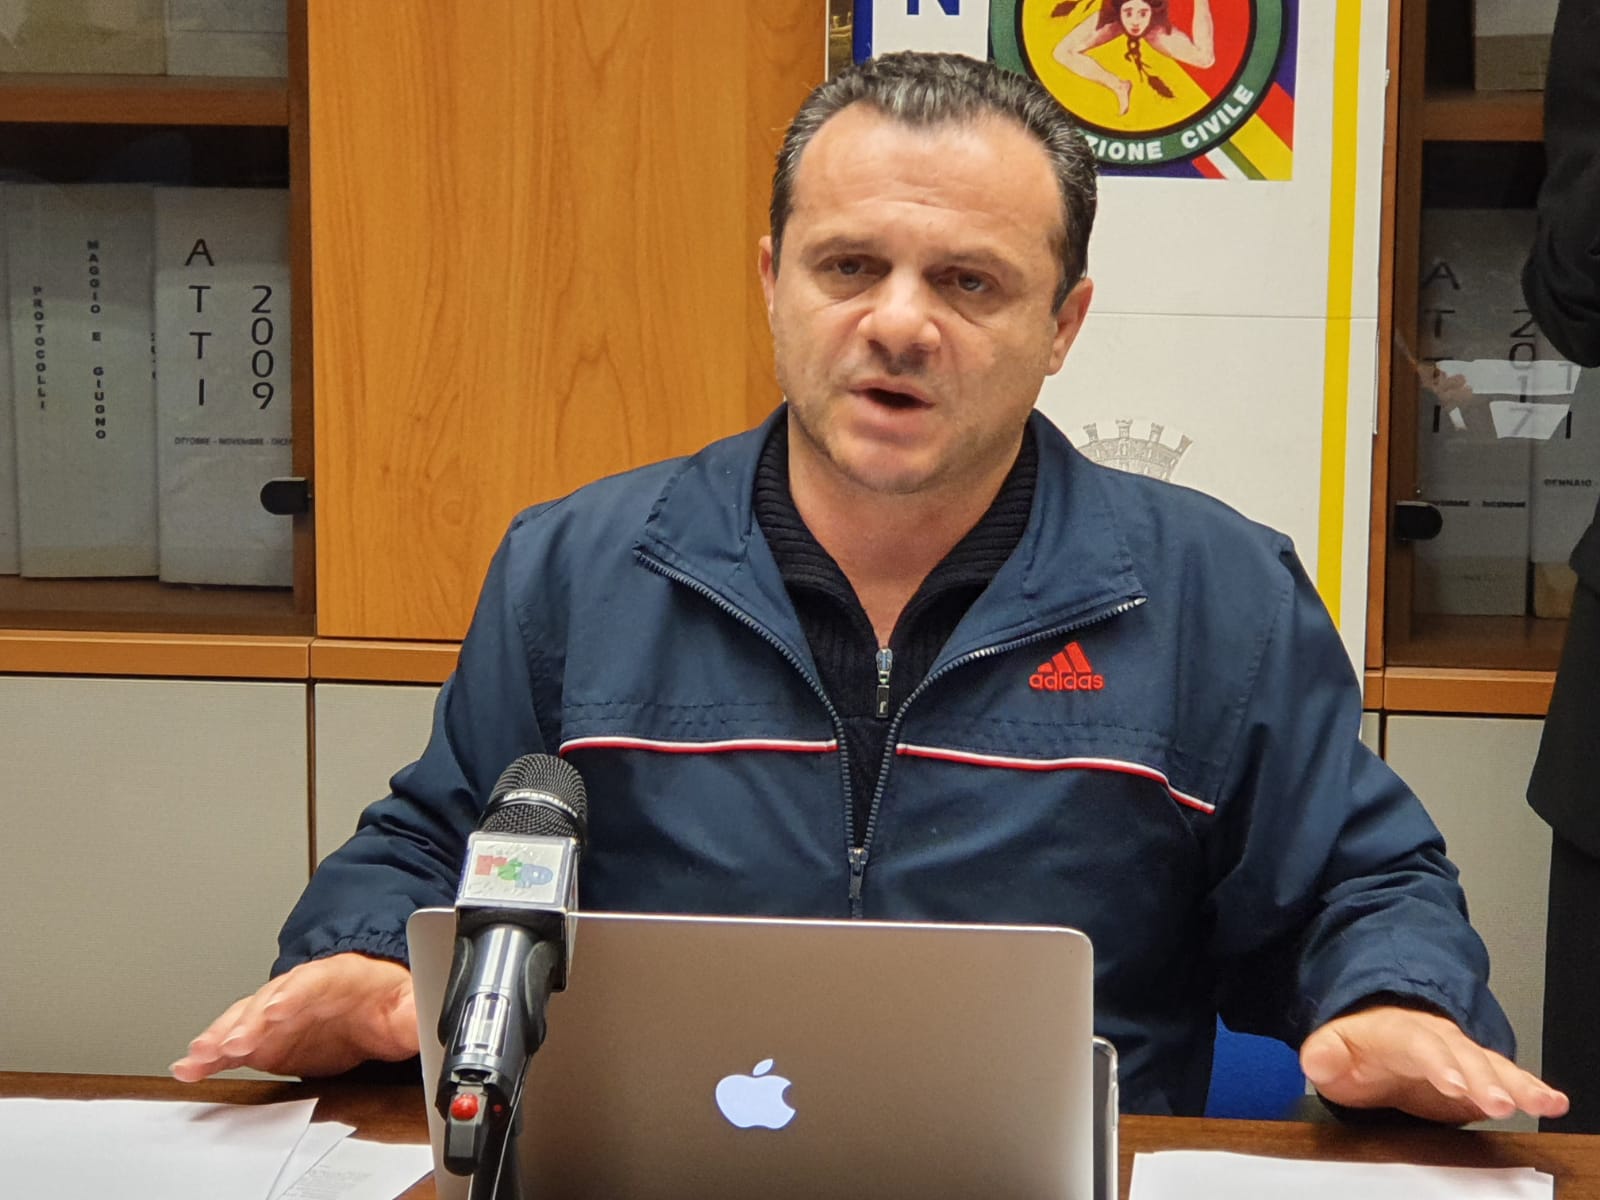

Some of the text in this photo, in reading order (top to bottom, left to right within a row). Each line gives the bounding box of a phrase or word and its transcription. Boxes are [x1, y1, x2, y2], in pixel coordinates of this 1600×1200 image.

[1181, 84, 1254, 149] CIVILE
[87, 240, 101, 314] MAGGIO
[33, 286, 47, 410] PROTOCOLLI
[92, 332, 101, 342] E
[185, 238, 215, 406] ATTI
[251, 285, 275, 410] 2009
[1028, 672, 1105, 691] adidas
